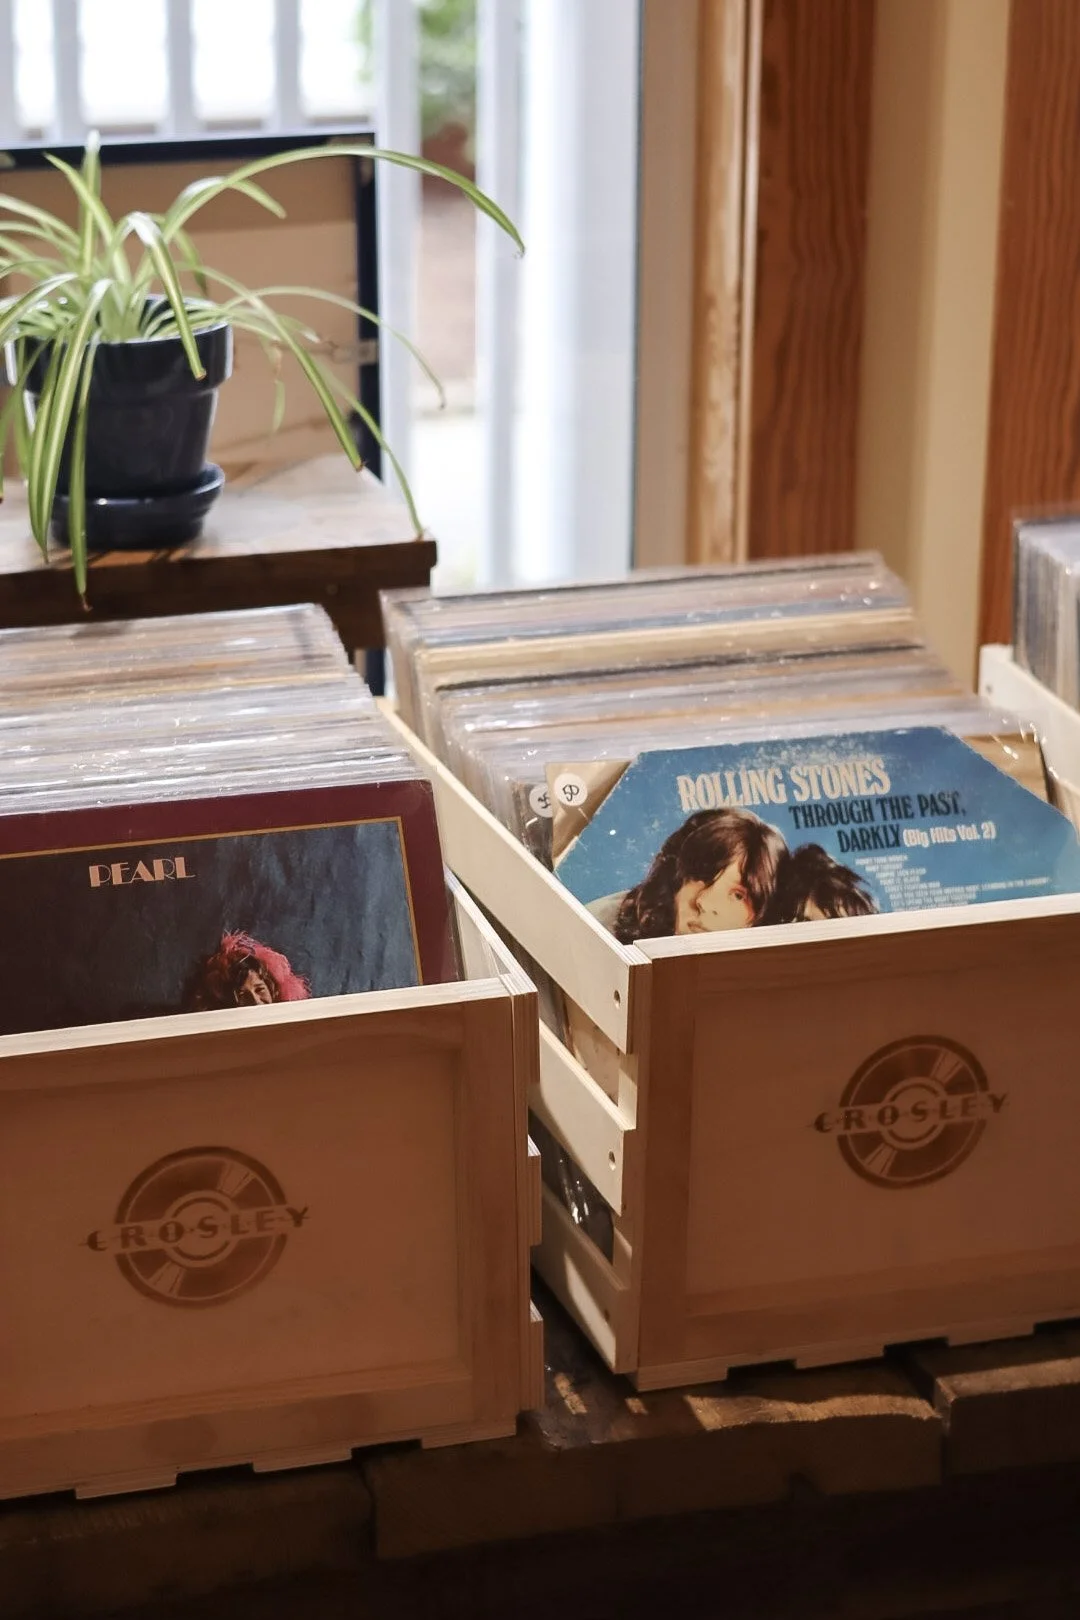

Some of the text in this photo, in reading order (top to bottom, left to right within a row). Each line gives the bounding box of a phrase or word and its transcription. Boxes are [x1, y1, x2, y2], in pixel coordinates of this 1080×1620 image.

[677, 758, 892, 812] ROLLING STONES
[788, 790, 967, 830] THROUGH THE PAST,
[837, 823, 901, 853] DARKLY
[930, 825, 957, 844] Hits
[957, 823, 980, 841] Vol.
[981, 820, 997, 840] 2)
[88, 856, 196, 888] PEARL
[810, 1092, 1008, 1134] CROSLEY
[80, 1205, 310, 1252] CROSLEY
